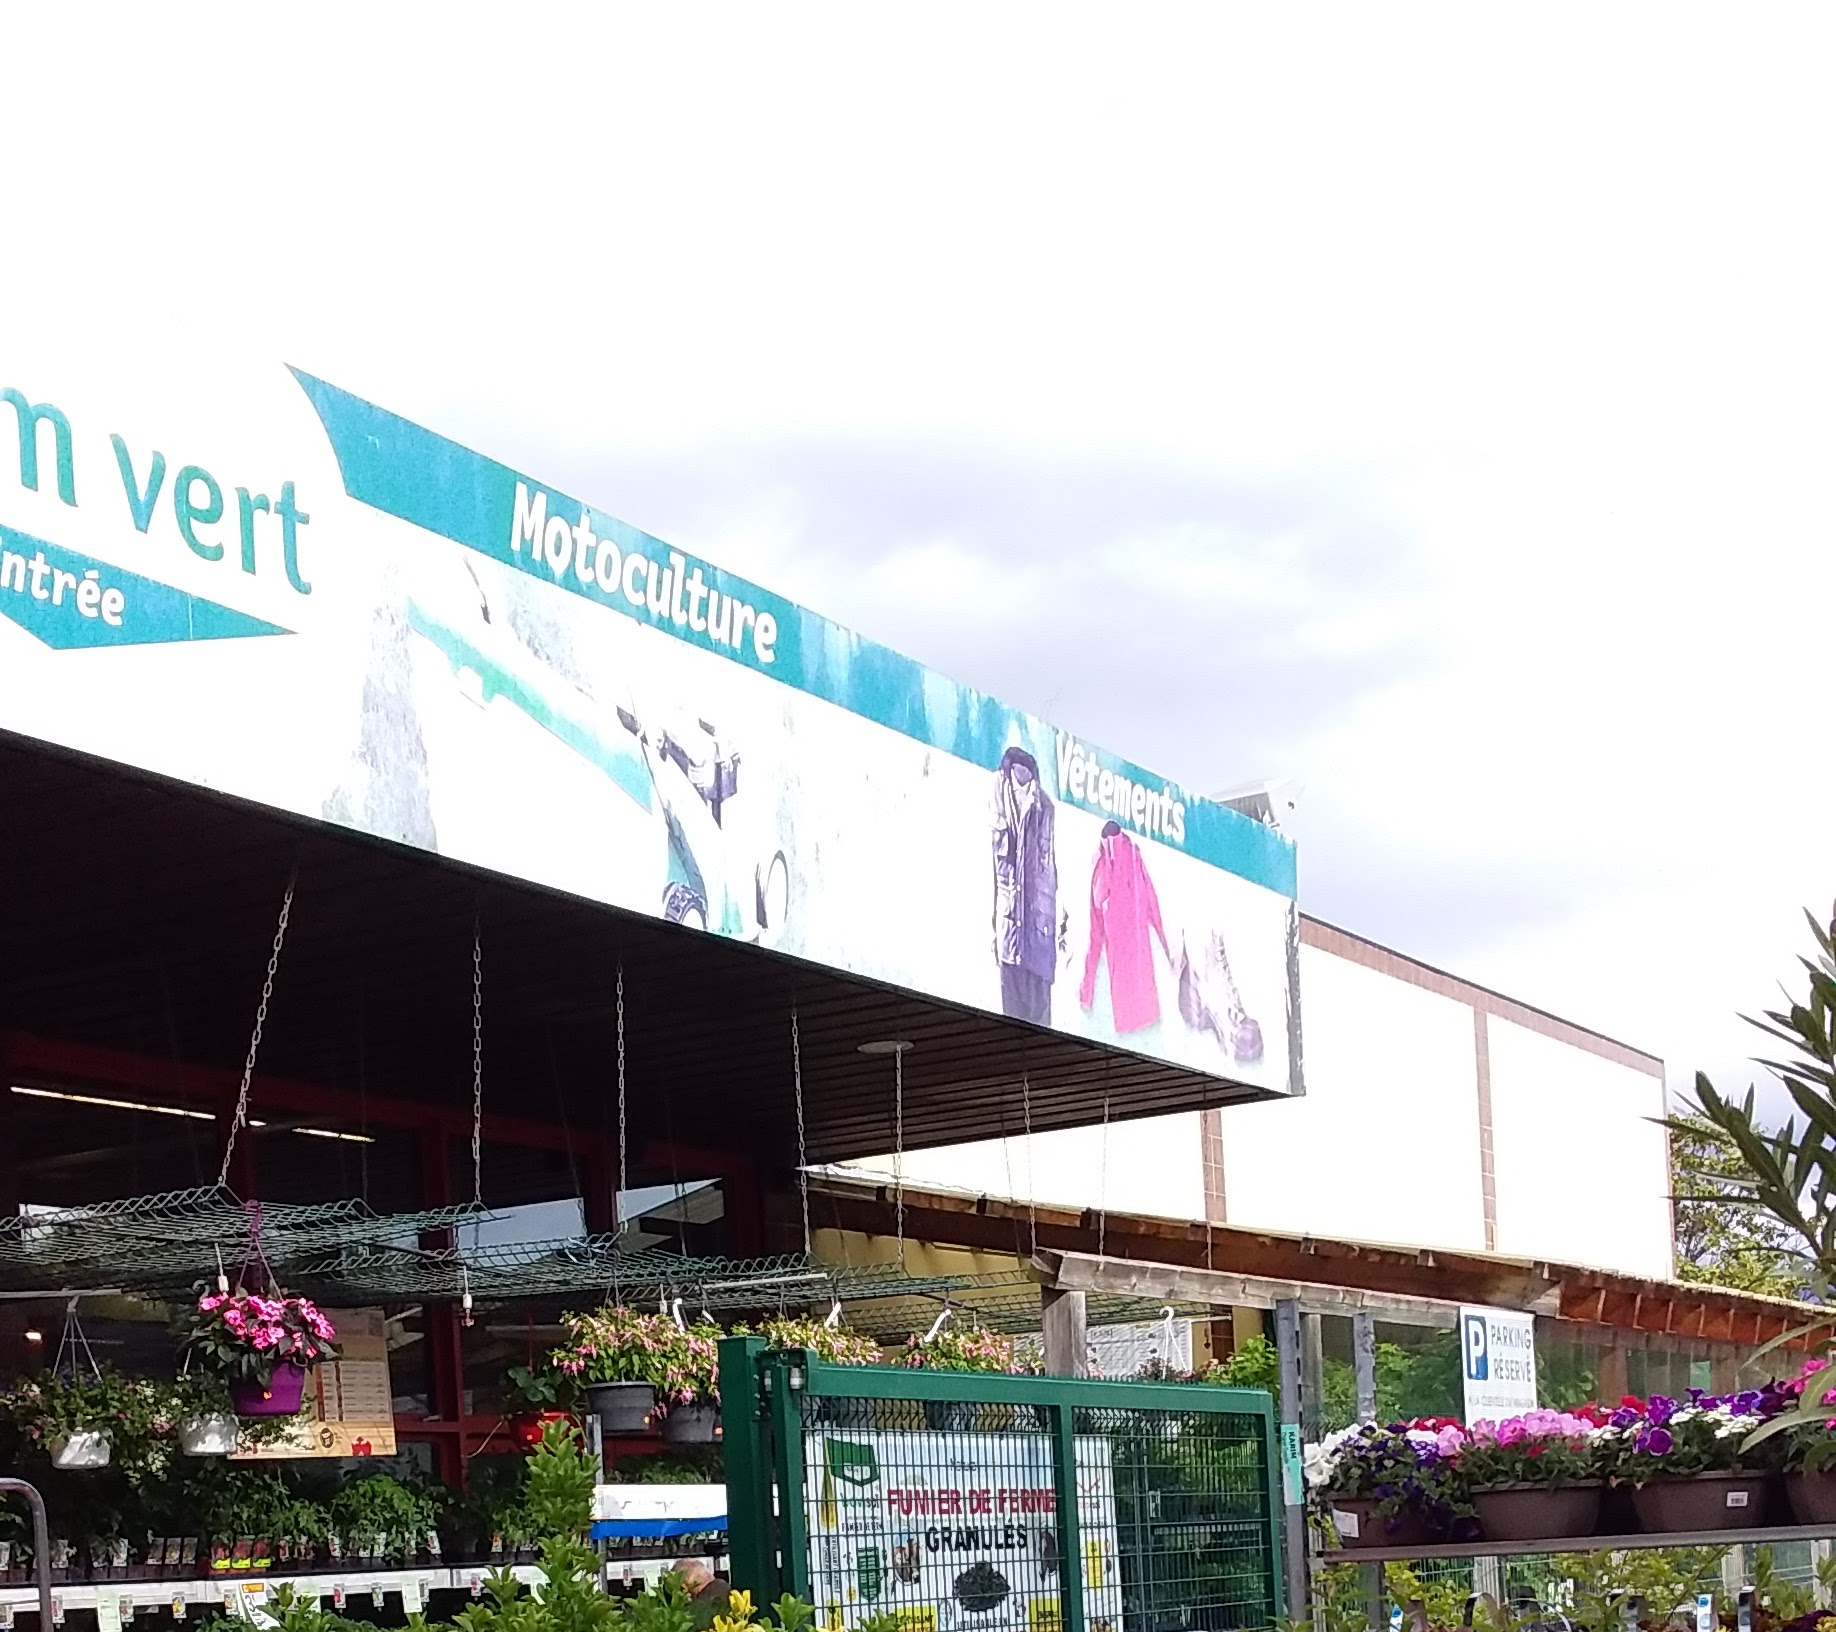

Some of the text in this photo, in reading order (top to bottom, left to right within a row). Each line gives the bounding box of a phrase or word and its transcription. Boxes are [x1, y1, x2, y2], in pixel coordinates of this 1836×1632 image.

[110, 433, 311, 594] vert
[0, 550, 124, 626] ntrée
[511, 481, 777, 662] Motoculture
[1055, 734, 1186, 844] Vêtements
[1491, 1324, 1532, 1350] PARKING
[1493, 1352, 1532, 1383] RÉSERVÉ
[887, 1488, 963, 1516] FUMIER
[968, 1488, 993, 1514] DE
[997, 1488, 1057, 1513] FERME
[925, 1517, 1028, 1553] GRANULÉS
